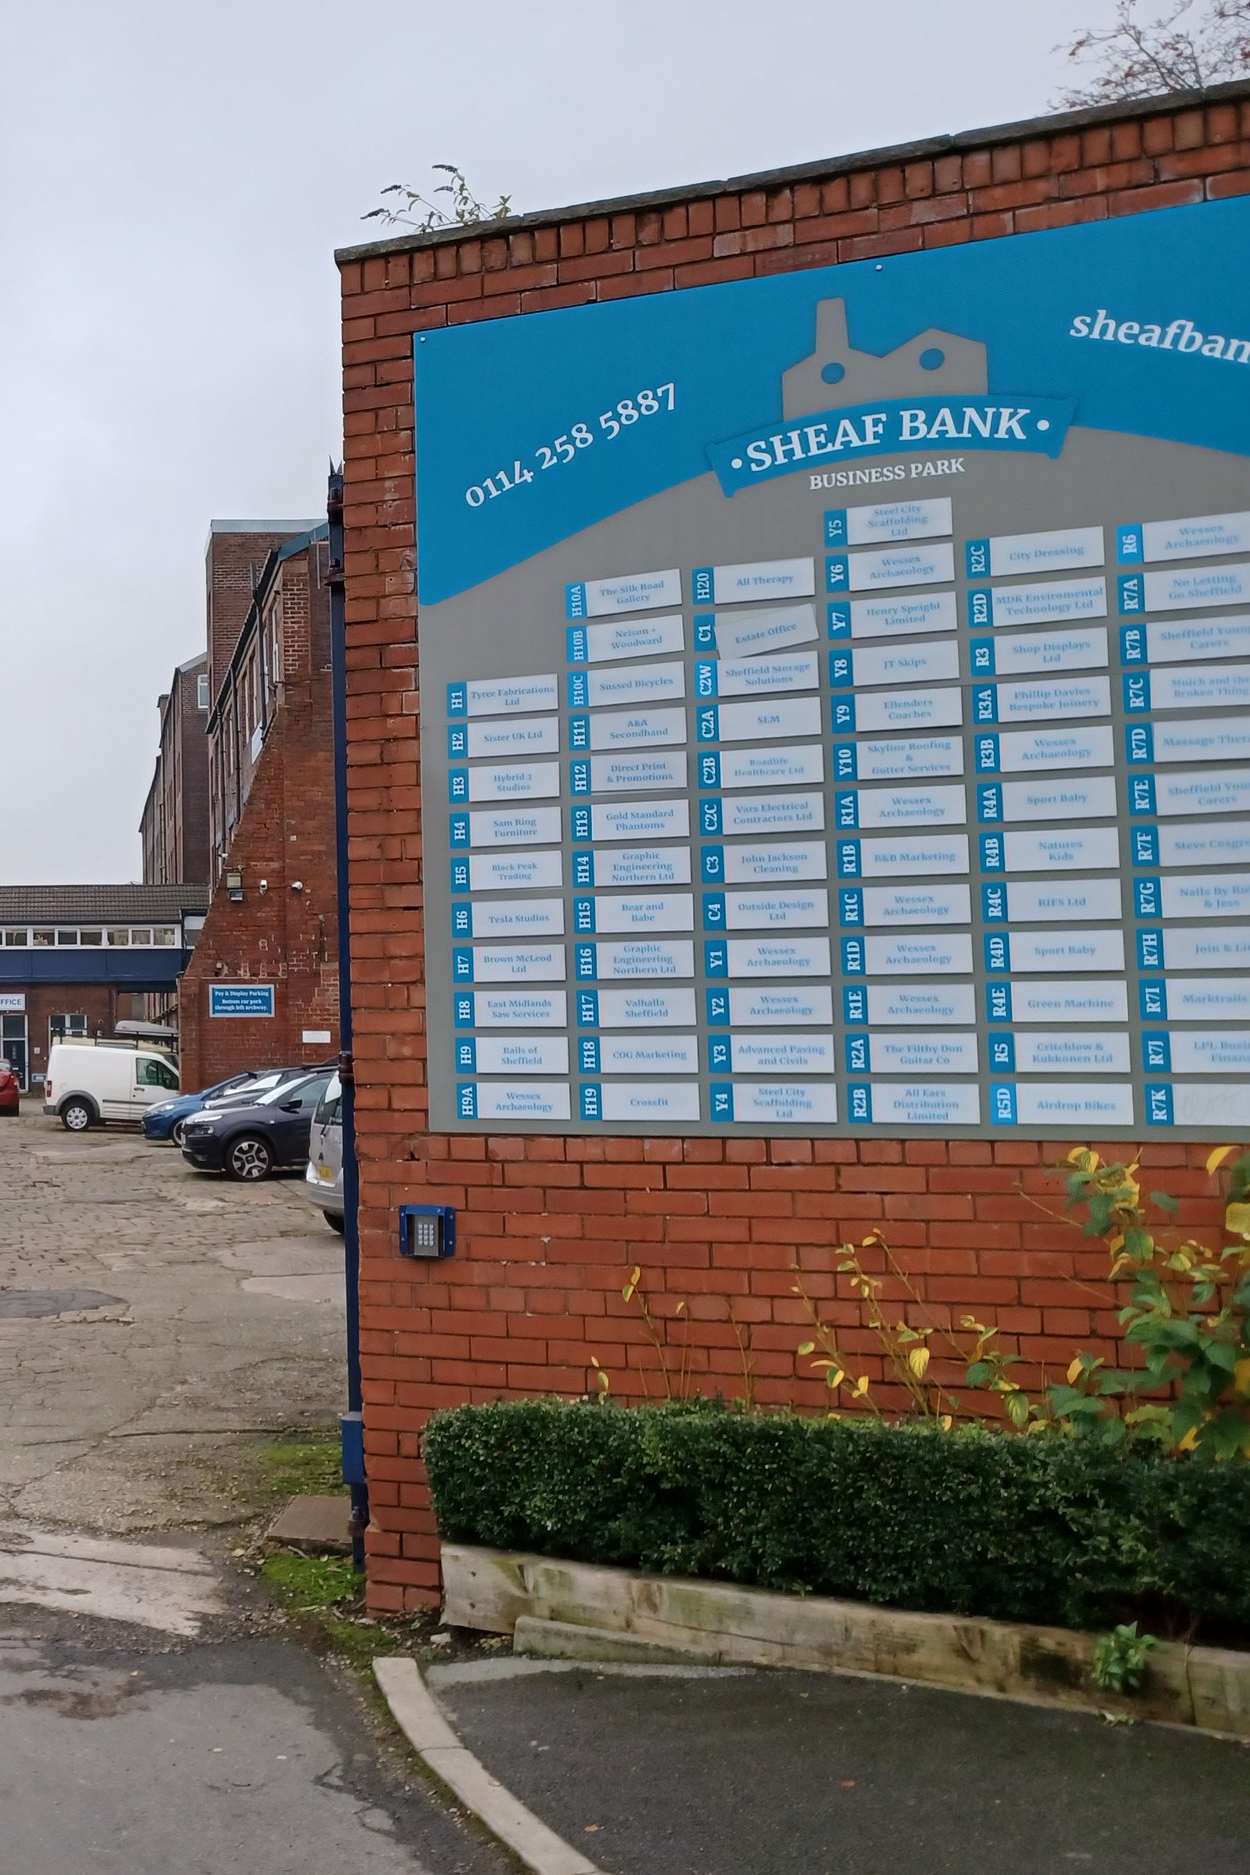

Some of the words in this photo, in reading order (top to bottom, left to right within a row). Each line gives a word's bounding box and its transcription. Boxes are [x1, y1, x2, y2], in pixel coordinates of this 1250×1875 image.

[466, 461, 534, 507] 0114
[535, 423, 593, 470] 258
[599, 383, 674, 440] 5887
[746, 414, 886, 472] SHEAF
[899, 408, 1031, 441] BANK
[809, 466, 905, 490] BUSINESS
[911, 458, 965, 478] PARK
[829, 520, 842, 537] Y5
[1123, 534, 1137, 554] R6
[971, 546, 985, 572] R2C
[698, 573, 710, 599] H20
[736, 577, 751, 587] All
[753, 574, 794, 586] Therapy
[830, 564, 844, 583] Y6
[571, 585, 582, 617] H10A
[1124, 579, 1138, 610] R7A
[973, 593, 987, 623] R2D
[699, 625, 711, 641] C1
[735, 632, 766, 644] Estate
[768, 623, 797, 636] Office
[832, 612, 846, 631] Y7
[573, 630, 584, 660] H10B
[975, 648, 989, 666] R3
[1126, 630, 1140, 660] R7B
[701, 665, 712, 695] C2W
[726, 666, 770, 677] Sheffield
[772, 663, 810, 673] Storage
[745, 676, 793, 686] Solutions
[834, 659, 847, 678] Y8
[574, 675, 584, 705] H10C
[600, 680, 632, 691] Sussed
[635, 677, 673, 689] Bicycles
[1129, 679, 1144, 708] R7C
[451, 691, 463, 708] H1
[979, 689, 992, 719] R3A
[701, 709, 714, 738] C2A
[757, 715, 780, 724] SEM
[836, 705, 850, 724] Y9
[453, 732, 463, 751] H2
[484, 733, 509, 742] Sister
[512, 733, 525, 741] UK
[527, 730, 543, 740] Ltd
[573, 720, 585, 746] H11
[1132, 729, 1146, 759] R7D
[839, 749, 852, 776] Y10
[981, 739, 994, 767] R3B
[574, 765, 586, 791] H12
[607, 775, 613, 783] &
[616, 772, 673, 783] Promotions
[611, 763, 639, 772] Direct
[642, 762, 666, 771] Print
[703, 757, 716, 784] C2B
[453, 777, 464, 795] H3
[1134, 780, 1149, 810] R7E
[606, 811, 629, 821] Gold
[631, 809, 674, 819] Standard
[841, 796, 854, 825] R1A
[984, 788, 997, 817] R4A
[576, 810, 588, 837] H13
[616, 821, 665, 831] Phantoms
[705, 804, 717, 831] C2C
[454, 822, 465, 840] H4
[741, 855, 765, 865] John
[768, 853, 807, 863] Jackson
[843, 845, 856, 873] R1B
[985, 838, 999, 867] R4B
[1138, 832, 1152, 860] R7F
[455, 866, 466, 884] H5
[578, 856, 589, 882] H14
[706, 856, 719, 874] C3
[753, 865, 799, 876] Cleaning
[844, 893, 858, 921] R1C
[988, 888, 1002, 917] R4C
[1141, 883, 1156, 913] R7G
[456, 911, 467, 929] H6
[489, 915, 513, 924] Tesla
[514, 913, 549, 923] Studios
[579, 902, 590, 929] H15
[708, 904, 721, 921] C4
[515, 954, 551, 963] McLeod
[581, 948, 592, 974] H16
[710, 950, 723, 967] Y1
[847, 941, 860, 970] R1D
[990, 938, 1004, 968] R4D
[1143, 934, 1157, 965] R7H
[458, 956, 469, 974] H7
[511, 965, 526, 973] Ltd
[459, 1000, 470, 1019] H8
[582, 995, 594, 1021] H17
[712, 997, 724, 1016] Y2
[849, 991, 863, 1019] R1E
[993, 988, 1006, 1017] R4E
[1028, 1000, 1061, 1009] Green
[1064, 999, 1113, 1007] Machine
[460, 1046, 472, 1064] H9
[584, 1041, 596, 1068] H18
[613, 1051, 633, 1059] COG
[636, 1050, 686, 1061] Marketing
[714, 1045, 726, 1063] Y3
[852, 1039, 865, 1068] R2A
[995, 1044, 1008, 1062] R5
[1149, 1041, 1164, 1065] R7J
[462, 1087, 474, 1116] H9A
[585, 1088, 597, 1115] H19
[630, 1098, 668, 1106] Crossfit
[716, 1093, 728, 1111] Y4
[854, 1089, 866, 1117] R2B
[997, 1089, 1012, 1119] R5D
[1037, 1101, 1081, 1111] Airdrop
[1084, 1101, 1116, 1110] Bikes
[1152, 1089, 1167, 1120] R7K
